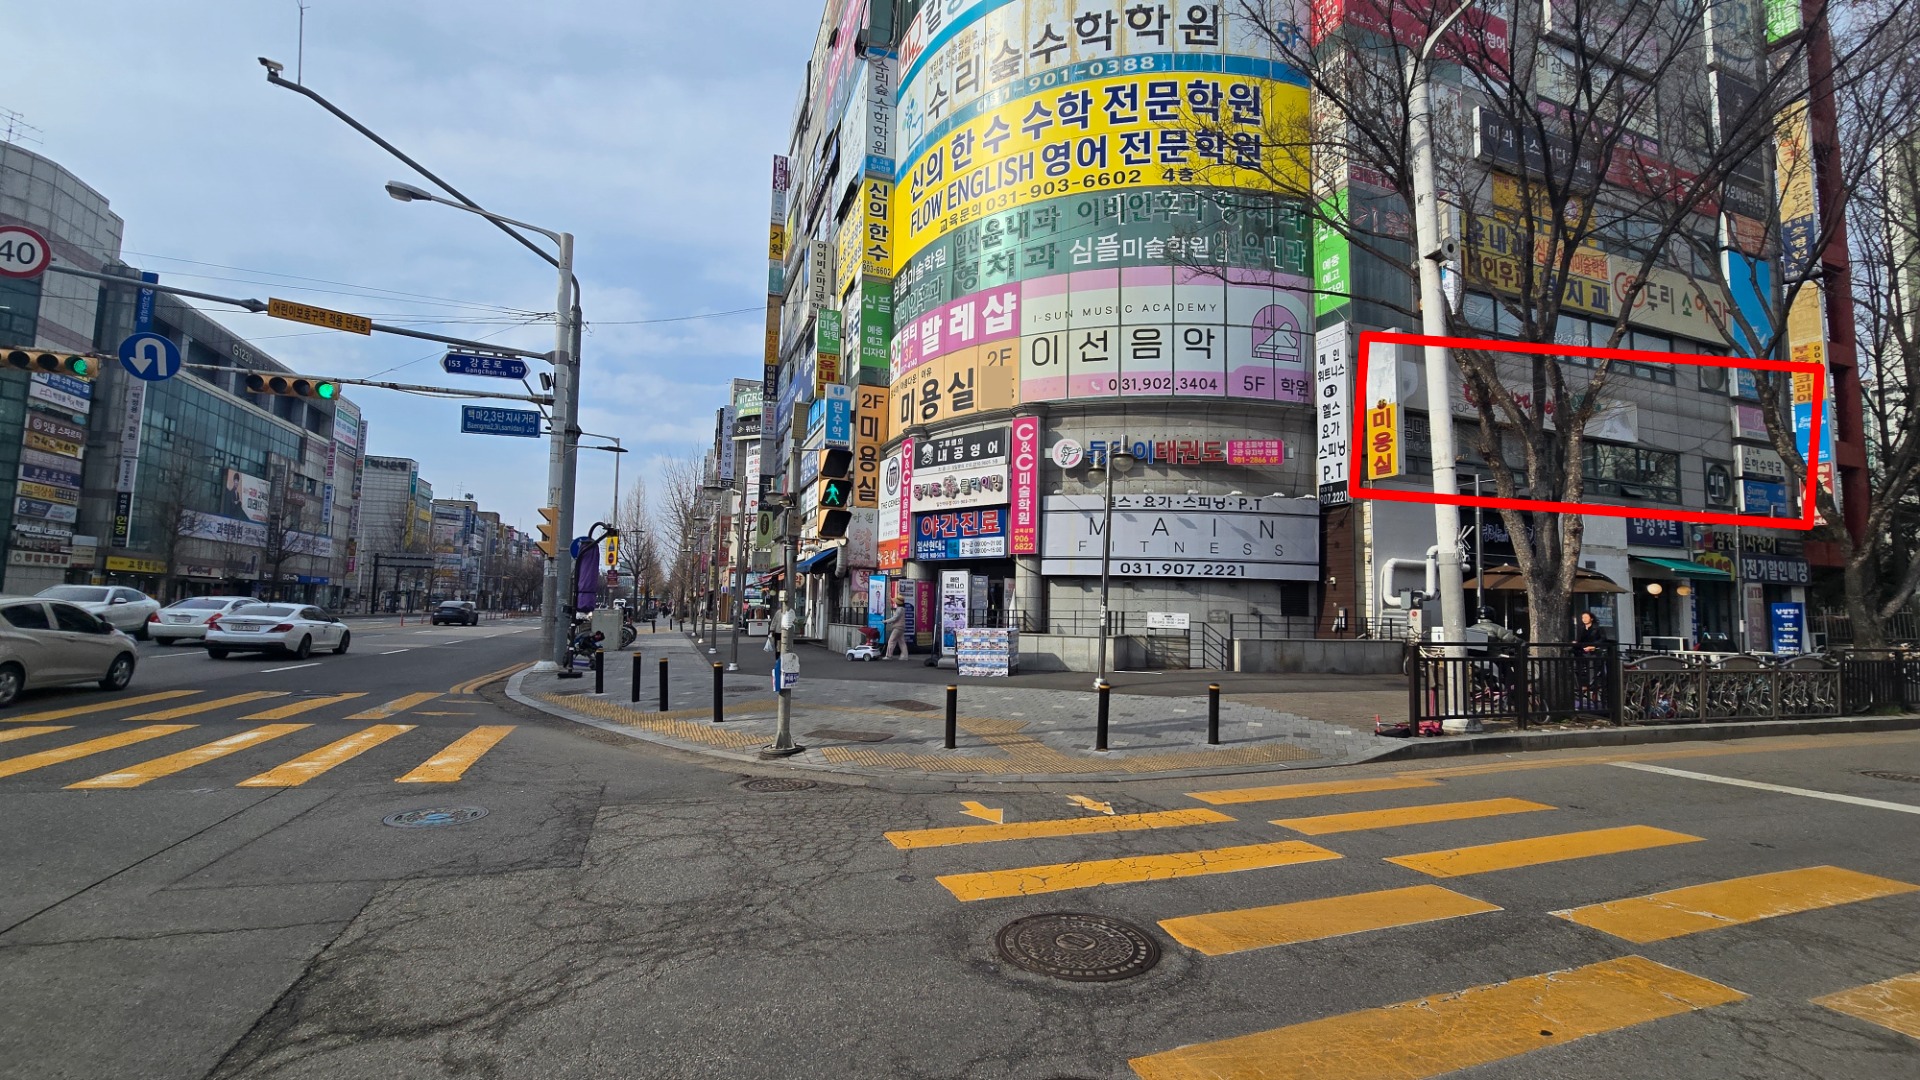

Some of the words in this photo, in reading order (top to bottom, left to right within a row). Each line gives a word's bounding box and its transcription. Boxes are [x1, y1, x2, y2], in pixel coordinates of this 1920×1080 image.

[911, 148, 946, 205] 신의
[1021, 86, 1093, 142] 수학
[1102, 80, 1262, 127] 전문학원
[910, 188, 943, 239] FLOW
[947, 150, 1035, 212] ENGLISH
[1041, 138, 1108, 177] 영어
[1118, 130, 1263, 168] 전문학원
[939, 201, 983, 234] 교육문의
[985, 169, 1142, 213] 031-903-6602
[1161, 167, 1194, 184] 4층
[1076, 190, 1208, 226] 이비인후과
[0, 240, 36, 264] 40
[1069, 232, 1211, 267] 심플미술학원
[862, 264, 892, 278] 903-6602
[893, 245, 947, 304] 심플미술학원
[862, 294, 891, 313] 심플
[1032, 308, 1075, 323] I-SUN
[1082, 304, 1134, 318] MUSIC
[1141, 302, 1218, 314] ACADEMY
[272, 301, 328, 325] 어린이보호구역
[328, 313, 344, 328] 적용
[819, 321, 840, 334] 미술
[868, 325, 884, 338] 예중
[902, 322, 918, 349] 큐티
[921, 292, 1017, 358] 발레샵
[822, 331, 840, 342] 학원
[867, 337, 884, 349] 예고
[863, 347, 887, 359] 디자인
[904, 344, 915, 364] 3F
[1031, 327, 1217, 367] 이선음악
[447, 358, 462, 369] 153
[469, 357, 503, 369] 강촌로
[510, 365, 524, 374] 157
[987, 347, 1013, 368] 2F
[1319, 348, 1341, 367] 메인
[464, 366, 508, 377] Gangchon-ro
[901, 367, 976, 424] 미용실
[1242, 374, 1267, 392] 5F
[1280, 377, 1311, 397] 학원
[861, 393, 885, 410] 2F
[1322, 401, 1342, 420] 헬스
[832, 402, 844, 438] 원수학
[1321, 421, 1341, 440] 요가
[937, 440, 999, 463] 내공영어
[1318, 440, 1347, 461] 스피닝
[1372, 410, 1394, 476] 미용실
[857, 414, 880, 502] 미용실
[1269, 456, 1279, 465] 6F
[1743, 456, 1779, 476] 은하수약국
[1016, 423, 1035, 525] C&C미술학원
[1323, 462, 1343, 481] P.T
[960, 474, 1005, 497] 클라이밍
[1746, 484, 1768, 498] Sunny
[1142, 497, 1173, 509] 요가
[1183, 498, 1226, 509] 스피닝
[1238, 499, 1263, 511] P.T
[1319, 490, 1348, 505] 907.2221
[1745, 495, 1770, 509] English
[920, 510, 1001, 539] 야간진료
[1089, 517, 1274, 539] MAIN
[1014, 543, 1035, 551] 6822
[1078, 540, 1284, 557] FITNESS
[1119, 562, 1246, 577] 031.907.2221
